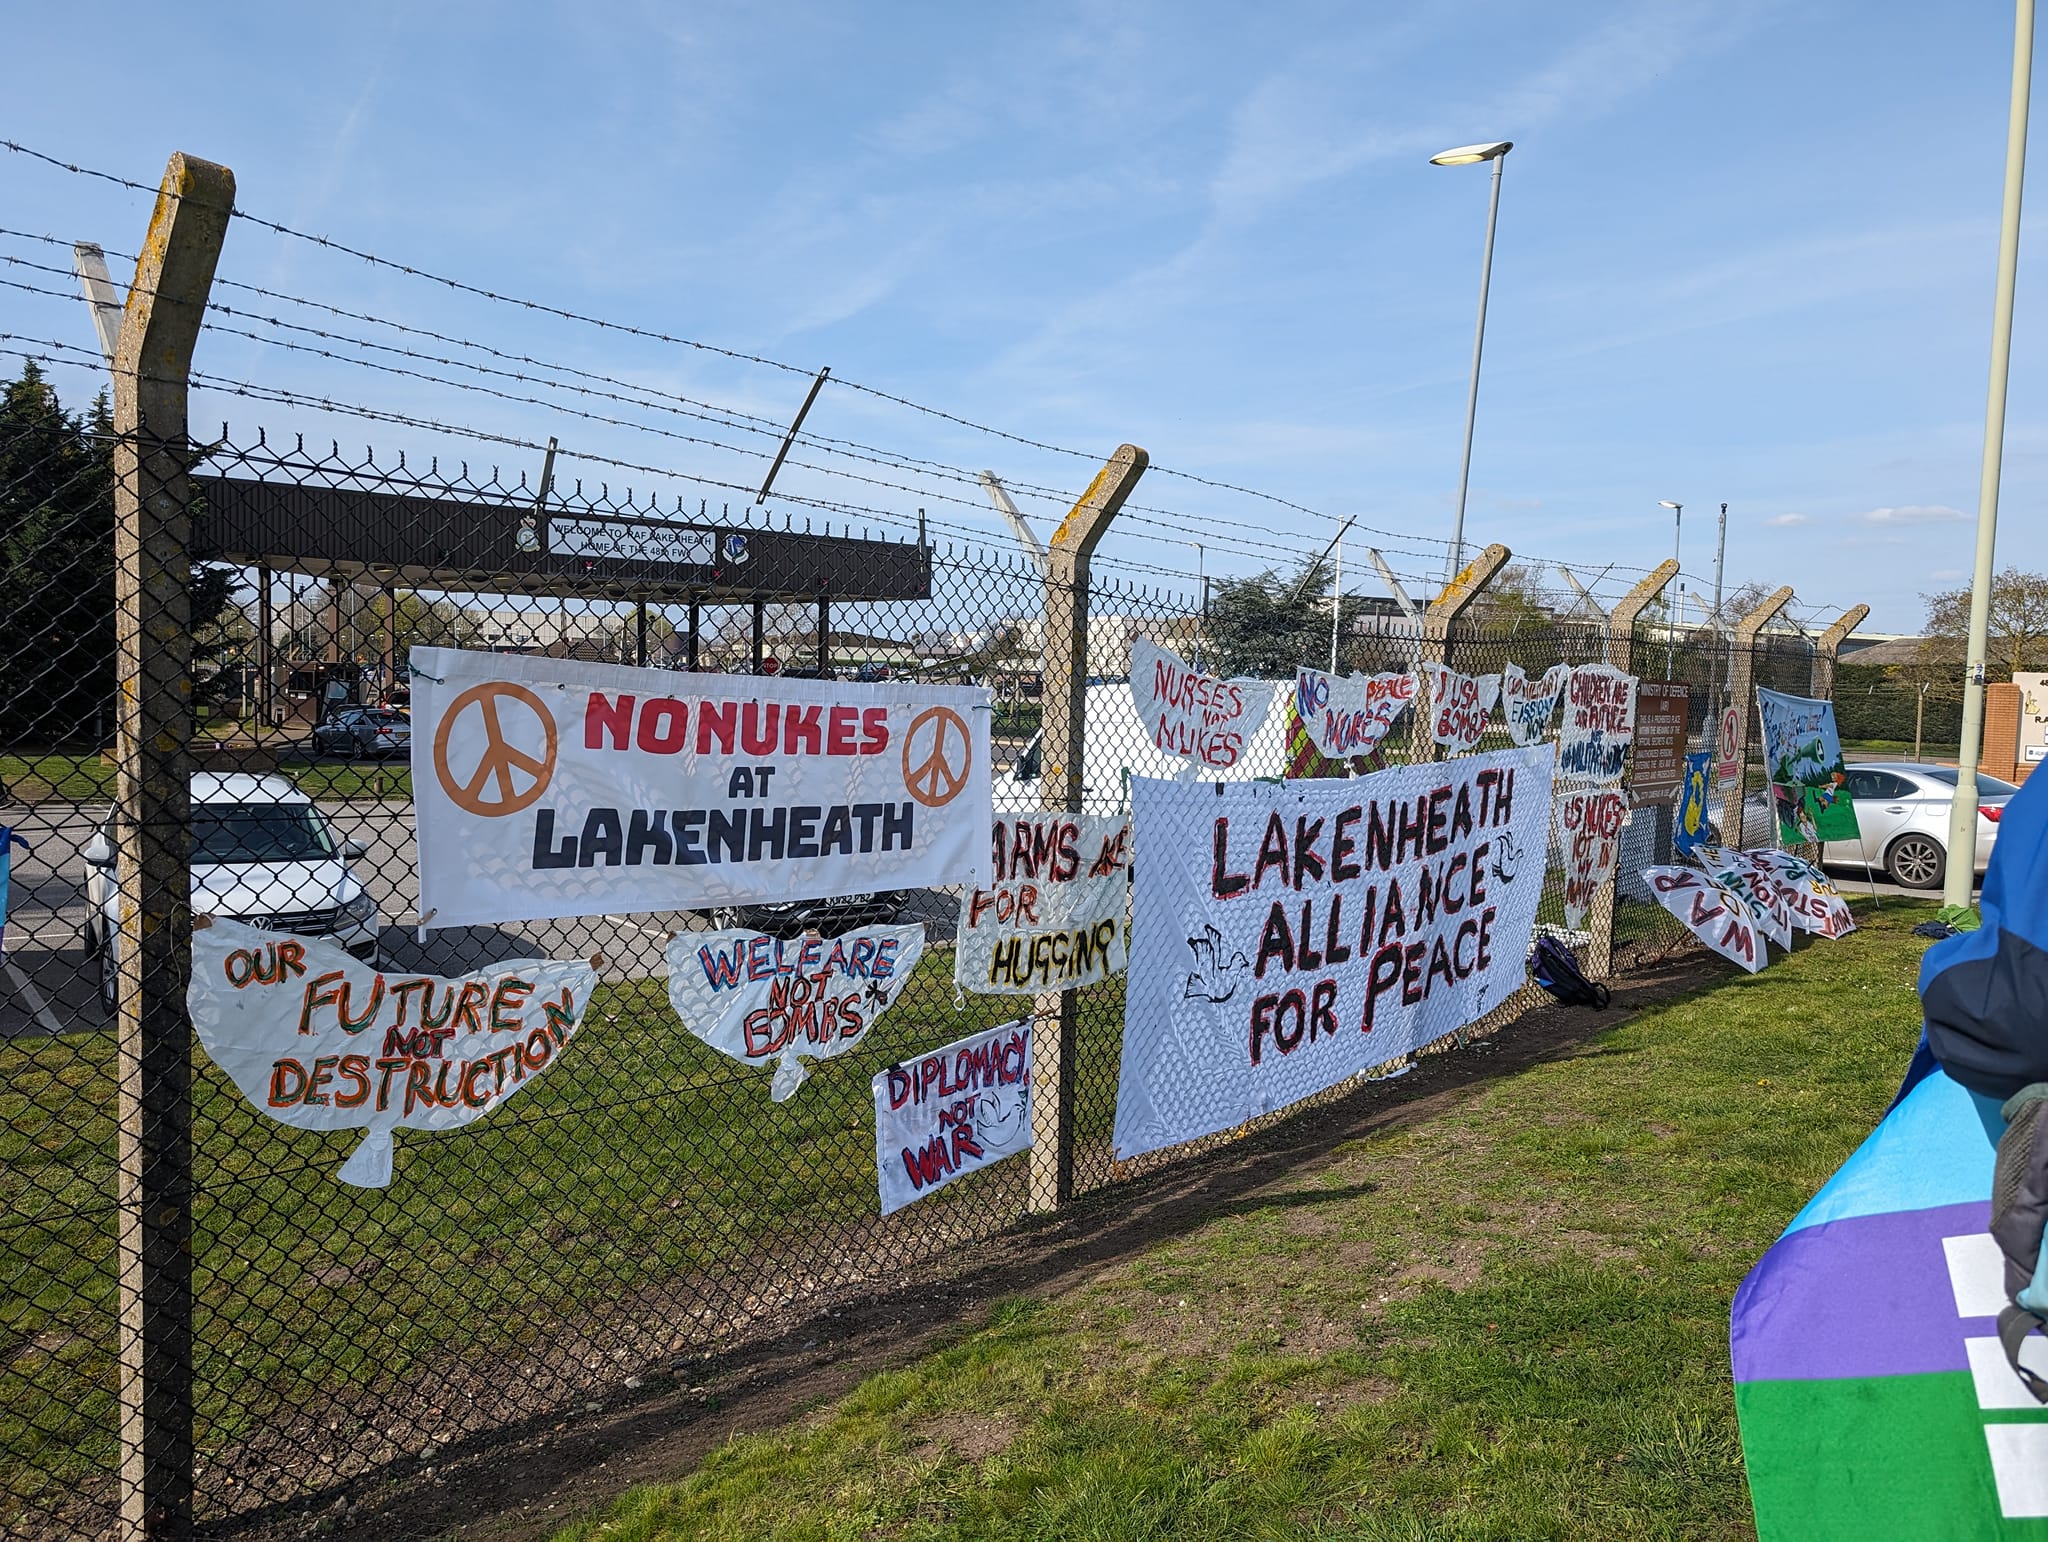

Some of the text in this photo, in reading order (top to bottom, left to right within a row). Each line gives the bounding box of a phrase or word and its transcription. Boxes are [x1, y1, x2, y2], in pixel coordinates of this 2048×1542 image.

[554, 524, 606, 538] WELCOME
[609, 528, 622, 538] TO
[627, 530, 646, 540] RAF
[581, 541, 610, 552] HOME
[614, 543, 626, 553] OF
[629, 545, 648, 554] THE
[1153, 659, 1243, 718] NURSES
[1298, 671, 1330, 718] NO
[1366, 675, 1414, 712] PEACE
[1451, 675, 1480, 710] USA
[1571, 671, 1614, 709] CHILDREN
[1662, 685, 1669, 697] OF
[584, 692, 890, 756] NO NUKES
[1157, 713, 1243, 768] NUKES
[1322, 701, 1392, 754] NUKES
[1437, 707, 1490, 744] BOMBS
[729, 766, 776, 799] AT
[532, 802, 914, 869] LAKENHEATH
[992, 819, 1081, 884] ARMS
[1212, 769, 1514, 900] LAKENHEATH
[968, 884, 1040, 929] FOR
[1254, 842, 1491, 979] ALLIANCE
[224, 939, 307, 989] OUR
[697, 935, 900, 992] WELFARE
[769, 969, 834, 1008] NOT
[1248, 906, 1497, 1067] FOR PEACE
[298, 970, 535, 1036] FUTURE
[267, 987, 576, 1118] DESTRUCTION
[383, 1025, 456, 1059] NOT
[887, 1029, 1030, 1111] DIPLOMACY
[938, 1092, 981, 1134] NOT
[901, 1123, 985, 1191] WAR
